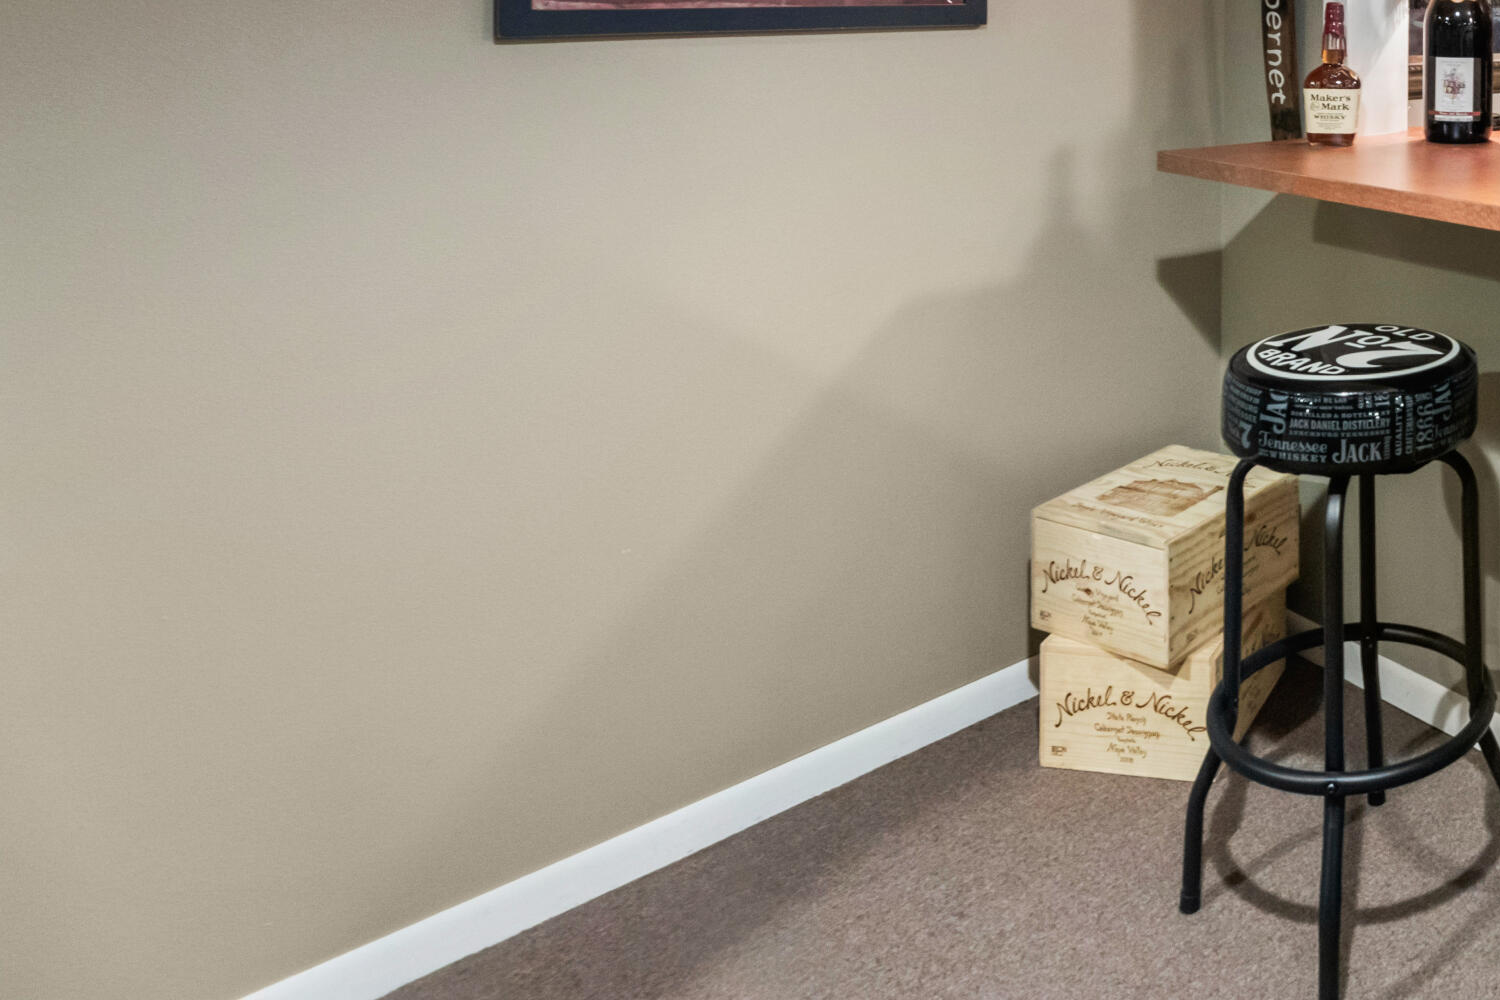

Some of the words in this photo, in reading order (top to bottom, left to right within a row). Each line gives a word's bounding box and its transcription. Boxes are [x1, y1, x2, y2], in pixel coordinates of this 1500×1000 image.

[1310, 94, 1351, 102] Maker's
[1375, 325, 1435, 341] OLD
[1257, 349, 1346, 375] BRAND
[1335, 341, 1445, 369] 7
[1289, 417, 1309, 428] JACK
[1311, 419, 1340, 430] DANIEL
[1342, 417, 1391, 430] DISTILLERY
[1415, 403, 1433, 451] 1866
[1258, 430, 1329, 453] Tennessee
[1332, 438, 1382, 463] JACK
[1269, 451, 1328, 463] WHISKEY
[1042, 559, 1091, 593] Nickel
[1092, 566, 1104, 581] &
[1104, 570, 1162, 625] Nickel
[1188, 557, 1224, 614] Nicke
[1054, 685, 1117, 728] Nickel
[1121, 690, 1135, 705] &
[1136, 692, 1206, 741] Nickel
